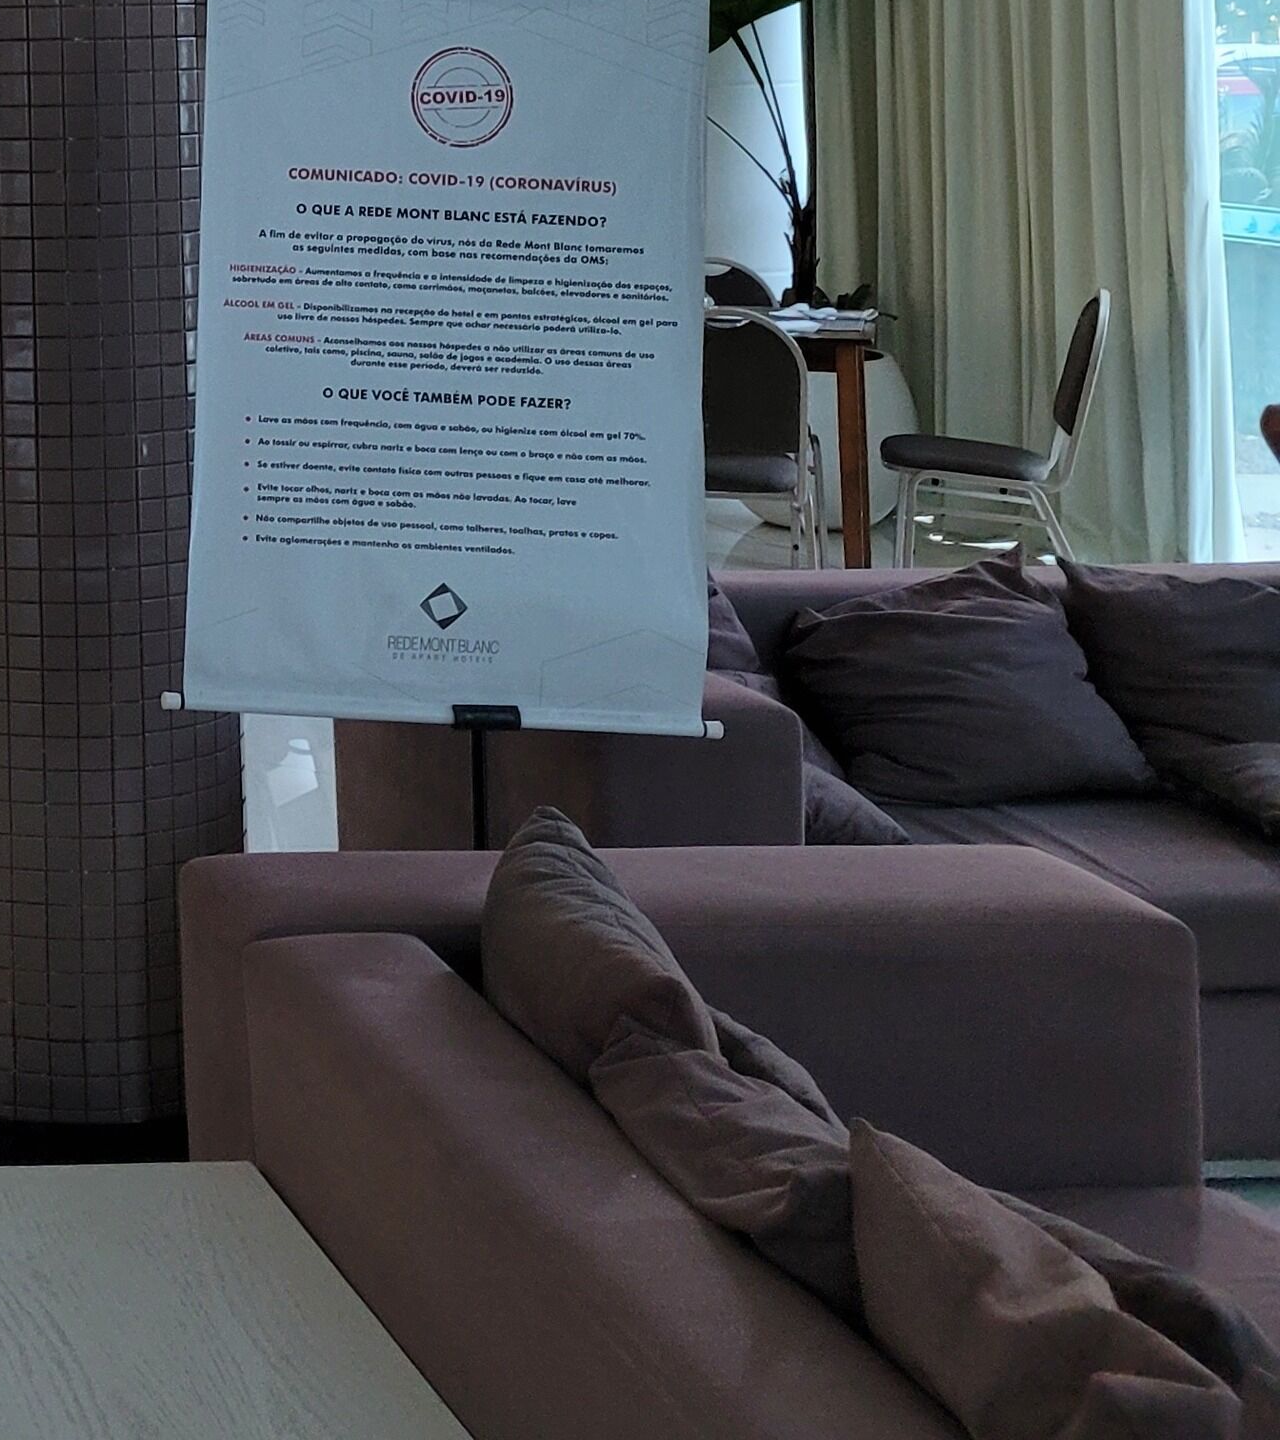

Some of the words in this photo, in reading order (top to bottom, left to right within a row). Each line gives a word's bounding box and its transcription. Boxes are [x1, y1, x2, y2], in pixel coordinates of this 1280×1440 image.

[419, 89, 506, 105] COVID-19
[289, 167, 403, 184] COMUNICADO:
[408, 172, 484, 188] COVID-19
[490, 176, 616, 195] (CORONAVÍRUS)
[296, 203, 307, 214] O
[312, 204, 341, 216] QUE
[344, 205, 354, 217] A
[358, 206, 392, 218] REDE
[396, 207, 440, 220] MONT
[444, 210, 490, 223] BLANC
[494, 210, 527, 224] ESTÁ
[531, 213, 607, 228] FAZENDO?
[269, 229, 286, 239] fim
[288, 230, 301, 239] de
[304, 231, 334, 241] evitar
[346, 235, 408, 245] propagação
[411, 235, 424, 245] do
[479, 238, 493, 248] da
[496, 239, 521, 249] Rede
[524, 240, 551, 250] Mont
[554, 242, 582, 252] Blanc
[585, 244, 644, 255] tomaremos
[292, 244, 304, 252] as
[307, 243, 355, 254] seguintes
[407, 249, 428, 257] com
[431, 248, 456, 258] base
[480, 253, 561, 264] recomendações
[563, 254, 577, 264] da
[351, 358, 386, 367] durante
[450, 363, 482, 372] deverá
[323, 387, 334, 399] O
[338, 388, 368, 400] QUE
[371, 387, 409, 402] VOCÊ
[413, 390, 473, 405] TAMBÉM
[478, 394, 516, 407] PODE
[520, 396, 571, 410] FAZER?
[258, 415, 279, 424] Lave
[414, 423, 438, 432] água
[495, 425, 537, 436] higienize
[560, 429, 587, 438] álcool
[606, 431, 621, 440] gel
[258, 437, 270, 446] Ao
[352, 442, 378, 450] cubra
[380, 444, 404, 452] nariz
[414, 444, 436, 453] boca
[459, 446, 484, 456] lenço
[528, 450, 555, 459] braço
[258, 460, 268, 468] Se
[270, 461, 300, 469] estiver
[363, 466, 396, 474] contato
[444, 470, 473, 478] outras
[476, 472, 512, 480] pessoas
[522, 473, 546, 482] fique
[257, 495, 290, 503] sempre
[305, 496, 329, 504] mãos
[352, 498, 375, 507] água
[258, 483, 279, 492] Evite
[281, 485, 304, 493] tocar
[334, 487, 357, 495] nariz
[368, 487, 390, 496] boca
[426, 492, 451, 500] mãos
[452, 493, 471, 501] não
[514, 495, 527, 504] Ao
[557, 497, 576, 506] lave
[256, 514, 275, 522] Não
[277, 516, 330, 525] compartilhe
[332, 517, 365, 527] objetos
[367, 518, 379, 527] de
[439, 524, 464, 532] como
[548, 530, 579, 538] pratos
[256, 534, 277, 543] Evite
[279, 536, 342, 547] aglomerações
[352, 540, 399, 549] mantenha
[414, 542, 462, 552] ambientes
